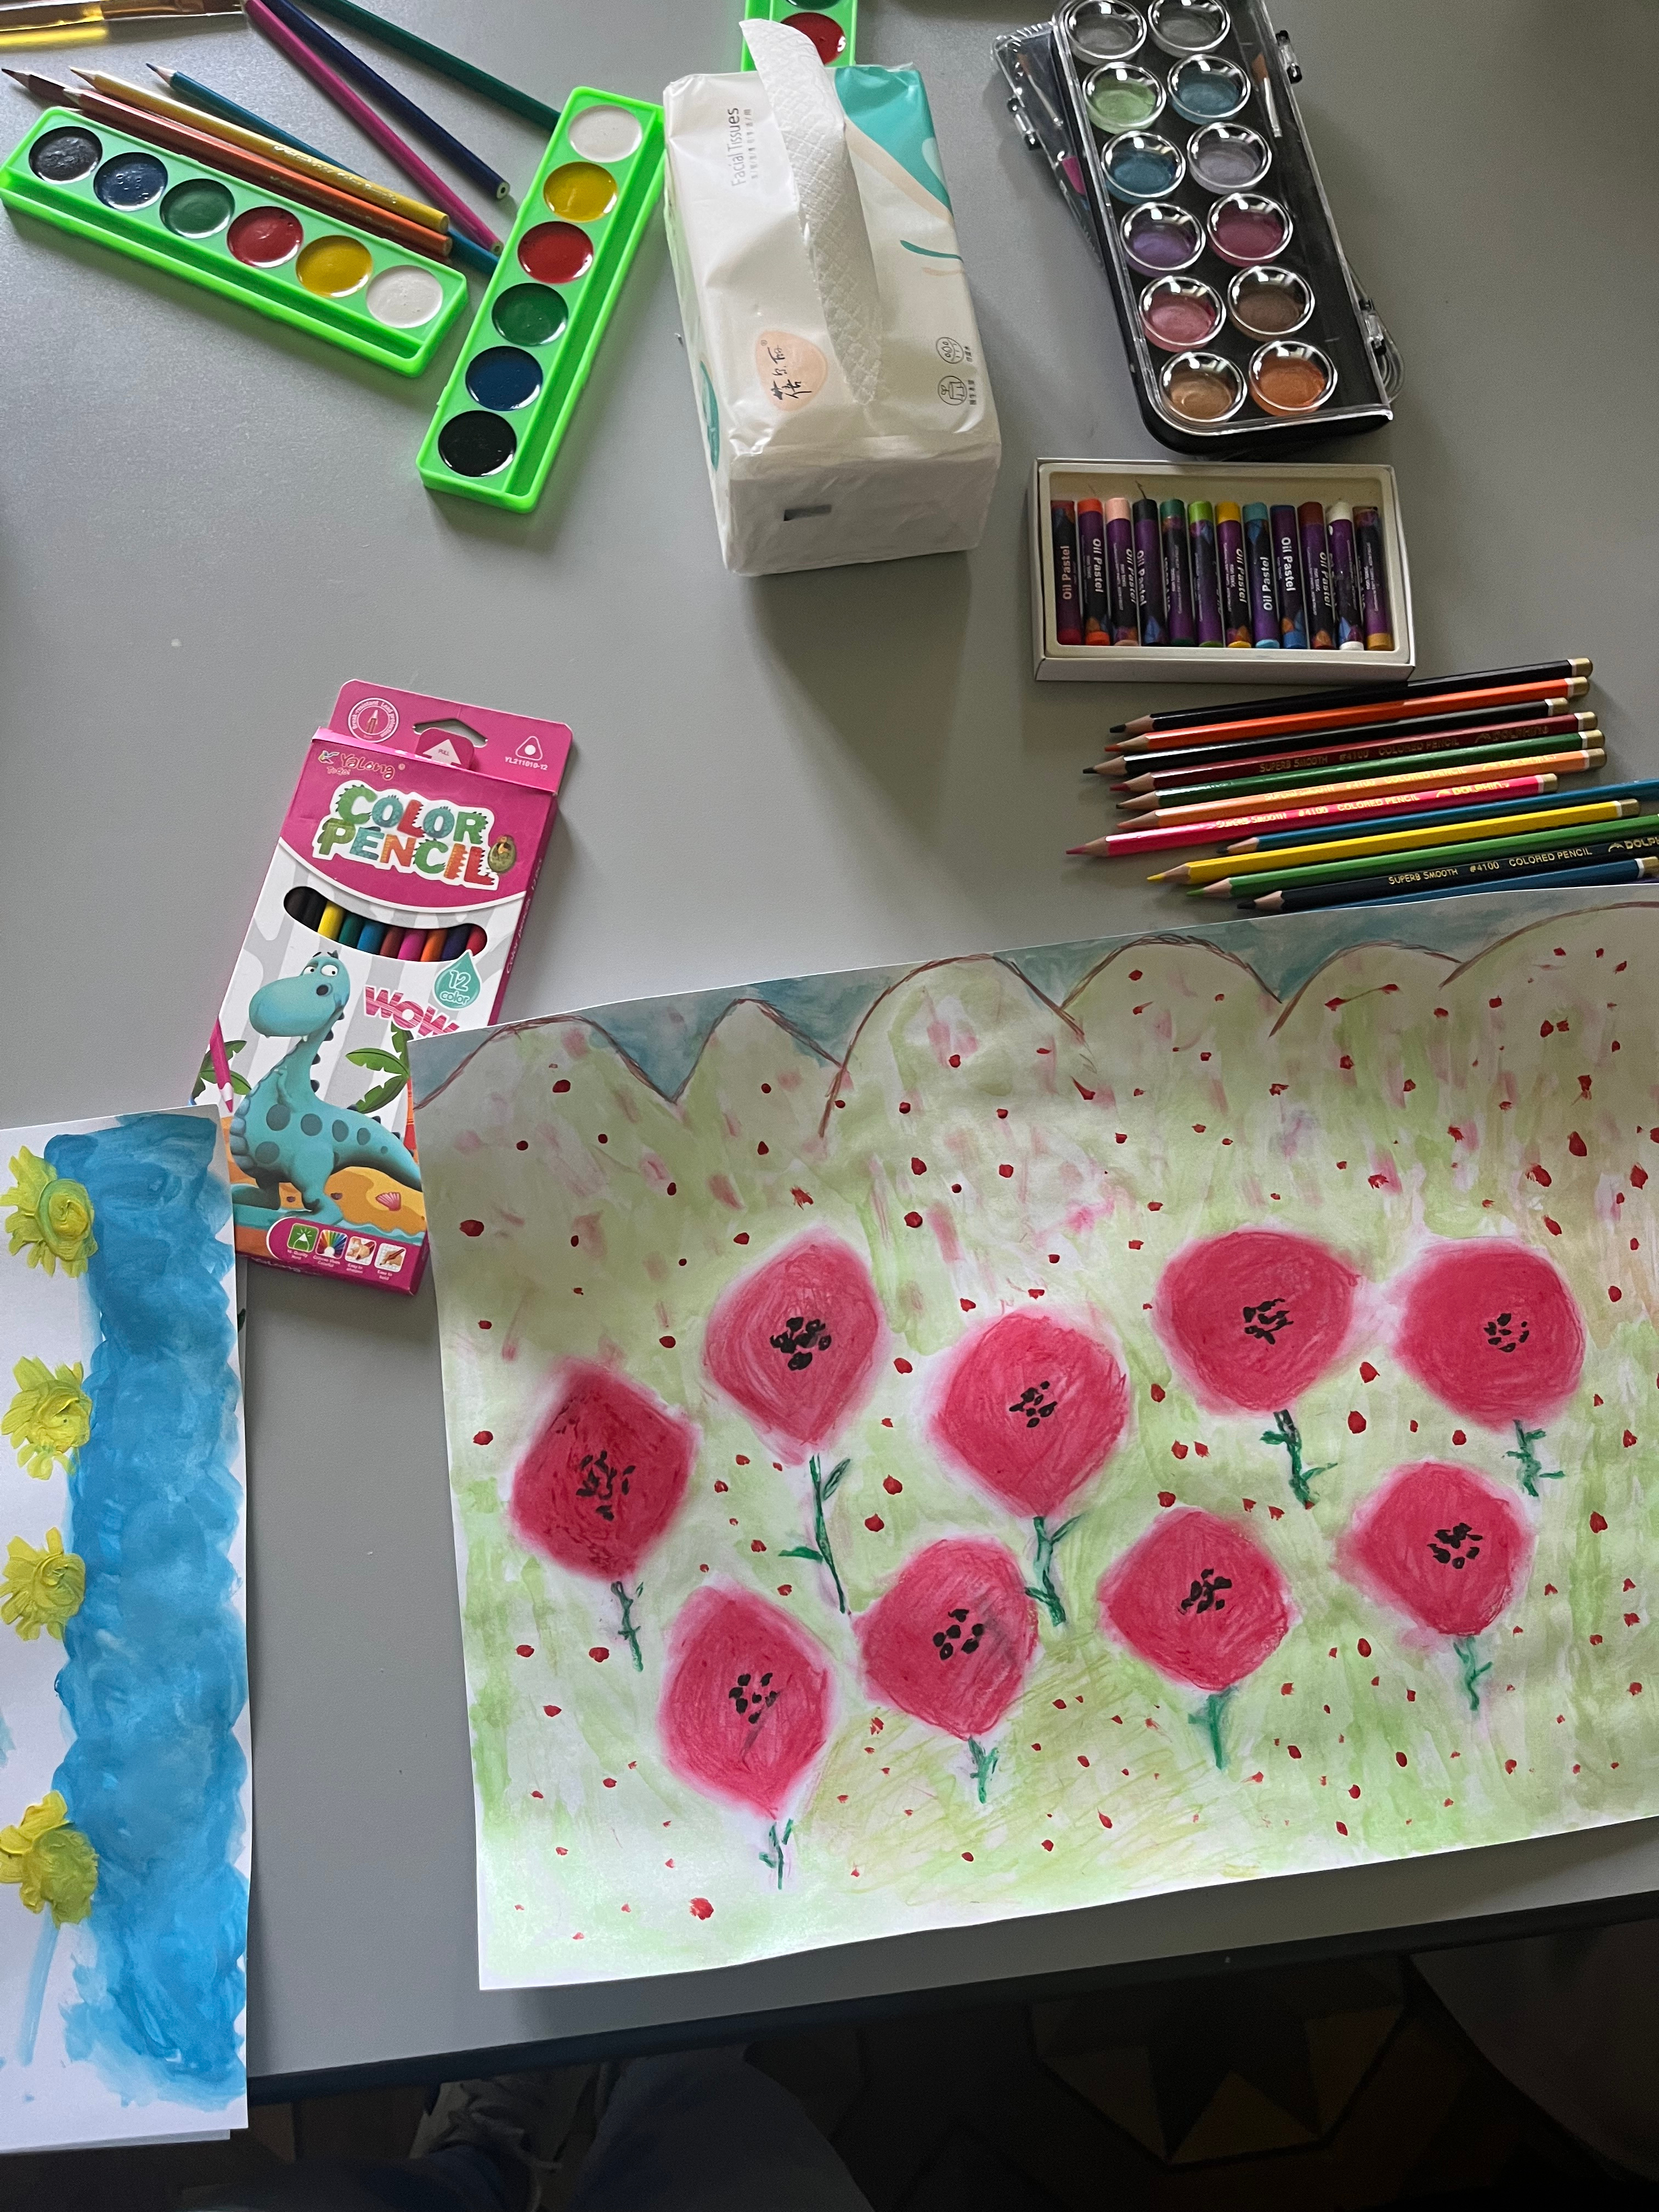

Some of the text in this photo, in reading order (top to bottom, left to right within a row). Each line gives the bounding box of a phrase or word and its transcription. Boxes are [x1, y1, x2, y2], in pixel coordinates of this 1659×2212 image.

[727, 108, 747, 187] Facial Tissues
[1060, 545, 1072, 600] Oil Pastel
[1093, 538, 1104, 593] Oil Pastel
[1127, 567, 1136, 604] Pastel
[1137, 550, 1147, 606] Oil Pastel
[1237, 567, 1247, 603] Pastel
[1260, 557, 1273, 611] Oil Pastel
[1282, 537, 1296, 591] Oil Pastel
[1319, 551, 1332, 607] Oil Pastel
[1426, 737, 1459, 750] PENCIL
[335, 784, 489, 845] COLOR
[1337, 799, 1383, 811] COLORED
[1385, 794, 1420, 805] PENCIL
[317, 817, 495, 885] PENCIL
[1389, 873, 1421, 885] SUPERB
[1423, 868, 1458, 880] SMOOTH
[1469, 861, 1500, 873] #4100
[1509, 853, 1555, 867] COLORED
[1557, 848, 1593, 860] PENCIL
[439, 991, 470, 1005] color
[448, 970, 471, 992] 12
[365, 986, 460, 1037] WOW
